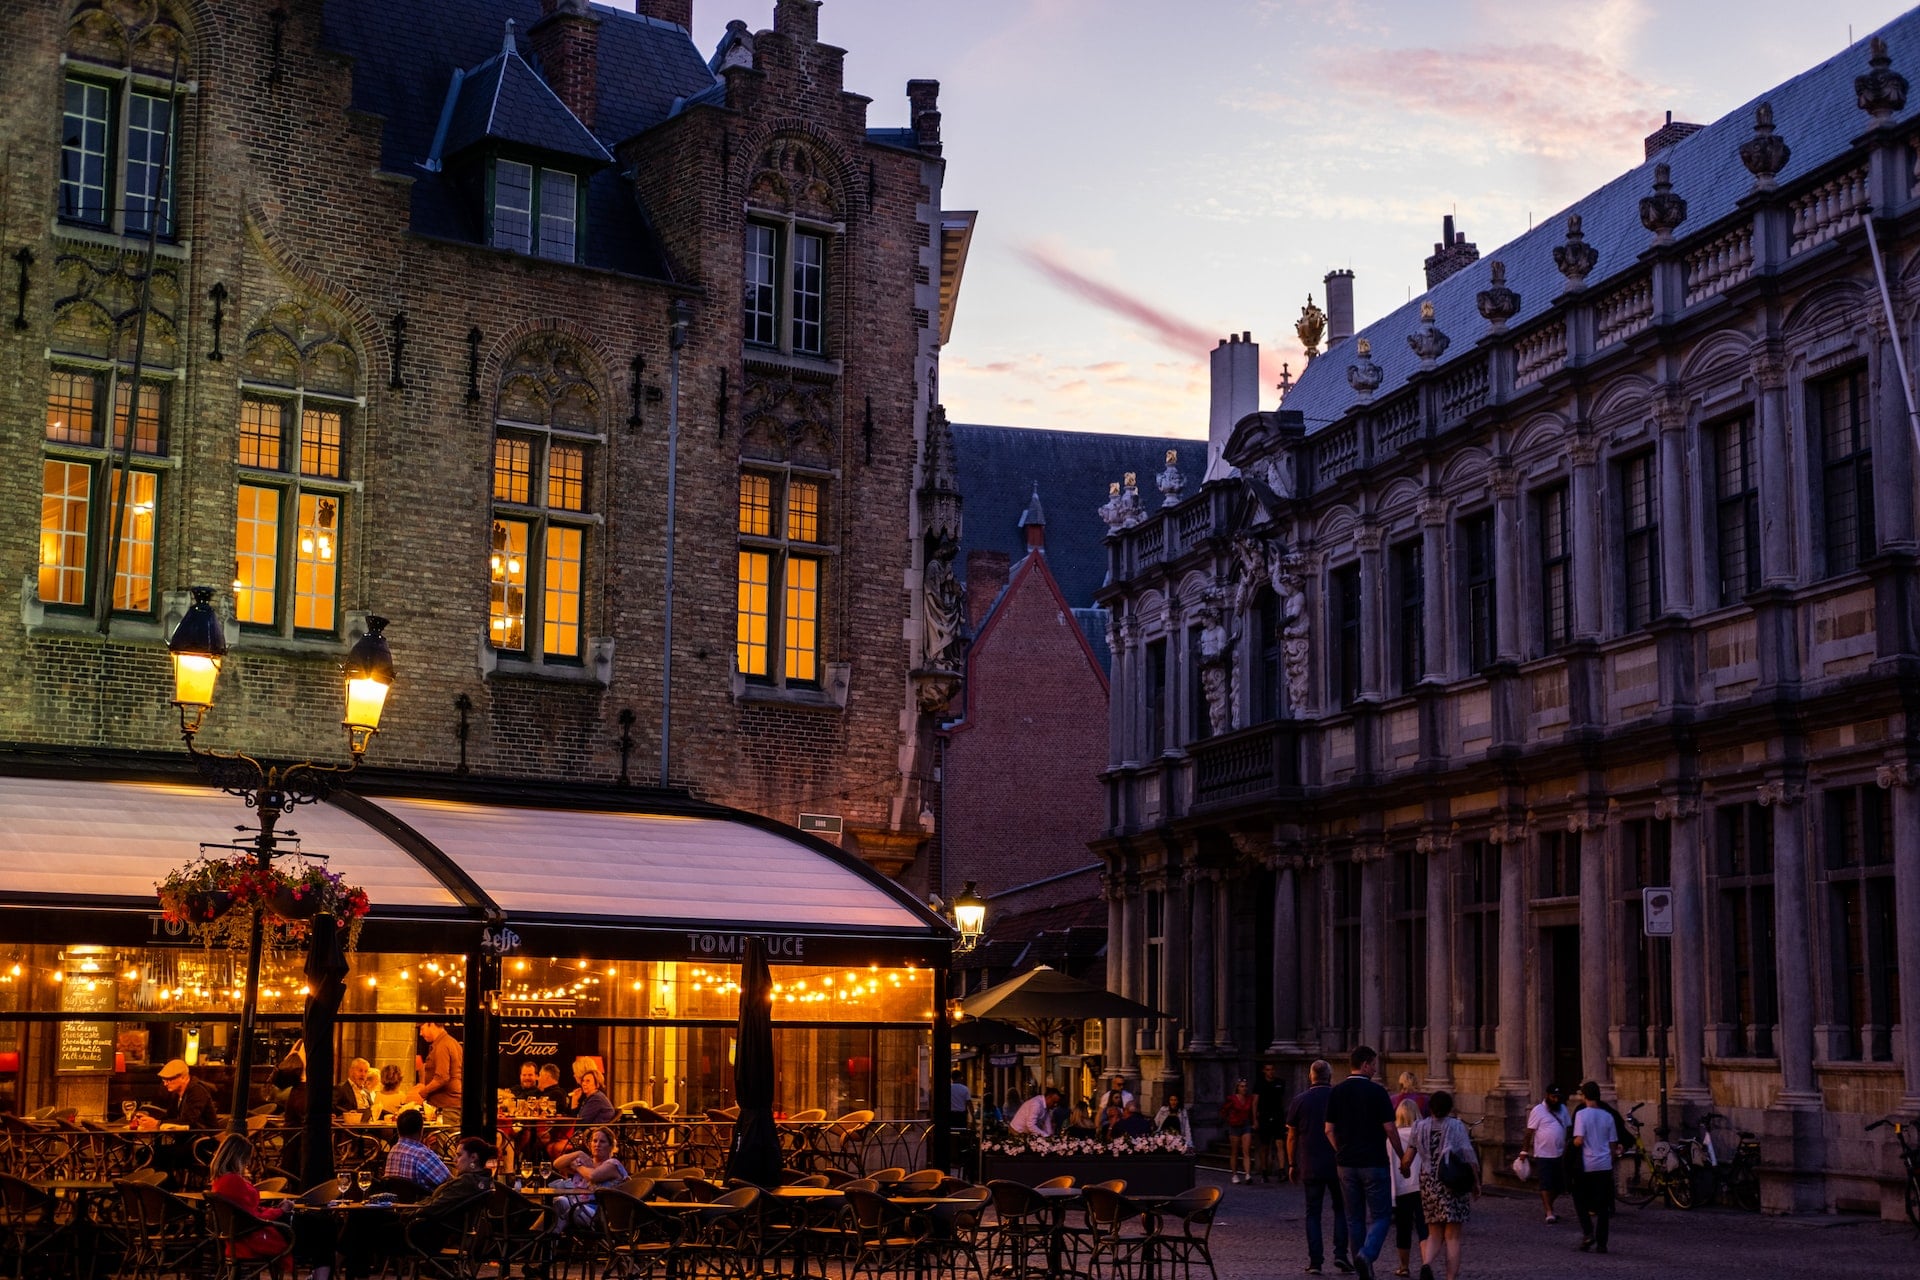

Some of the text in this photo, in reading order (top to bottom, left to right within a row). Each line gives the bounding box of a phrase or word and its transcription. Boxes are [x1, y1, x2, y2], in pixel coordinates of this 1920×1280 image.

[481, 927, 521, 952] Leffe
[687, 933, 804, 956] TOMUCE
[444, 1006, 576, 1027] RURANT
[506, 1030, 557, 1055] Pouce
